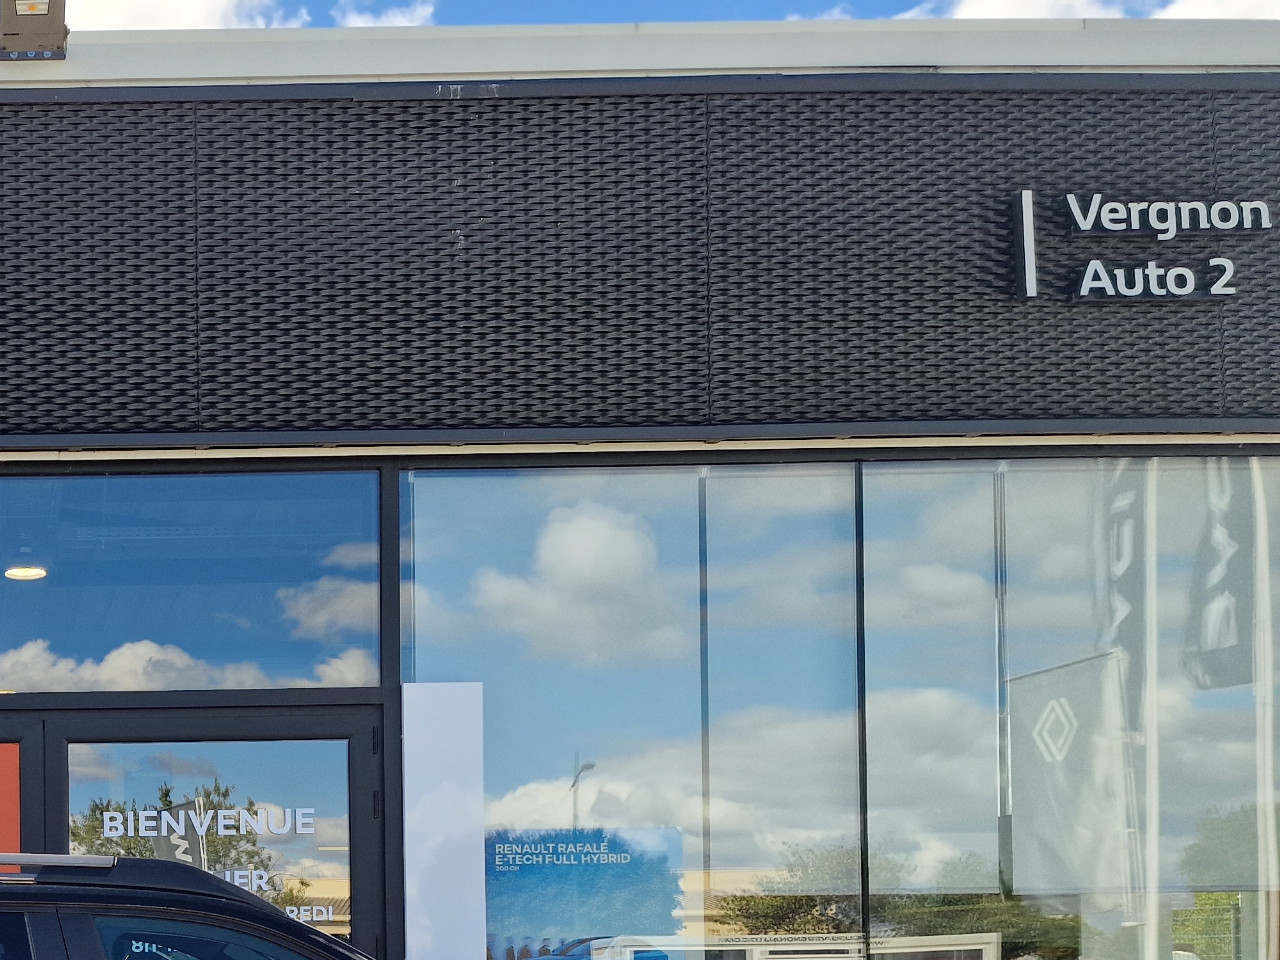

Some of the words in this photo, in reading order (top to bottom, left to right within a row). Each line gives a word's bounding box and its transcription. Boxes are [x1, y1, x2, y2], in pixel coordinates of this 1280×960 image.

[1065, 193, 1272, 241] Vergnon
[1079, 259, 1196, 297] Auto
[1208, 257, 1237, 295] 2
[102, 807, 316, 838] BIENVENUE
[495, 843, 555, 854] RENAULT
[557, 842, 609, 853] RAFALE
[495, 854, 543, 865] E-TECH
[545, 854, 578, 864] FULL
[581, 853, 631, 864] HYBRID
